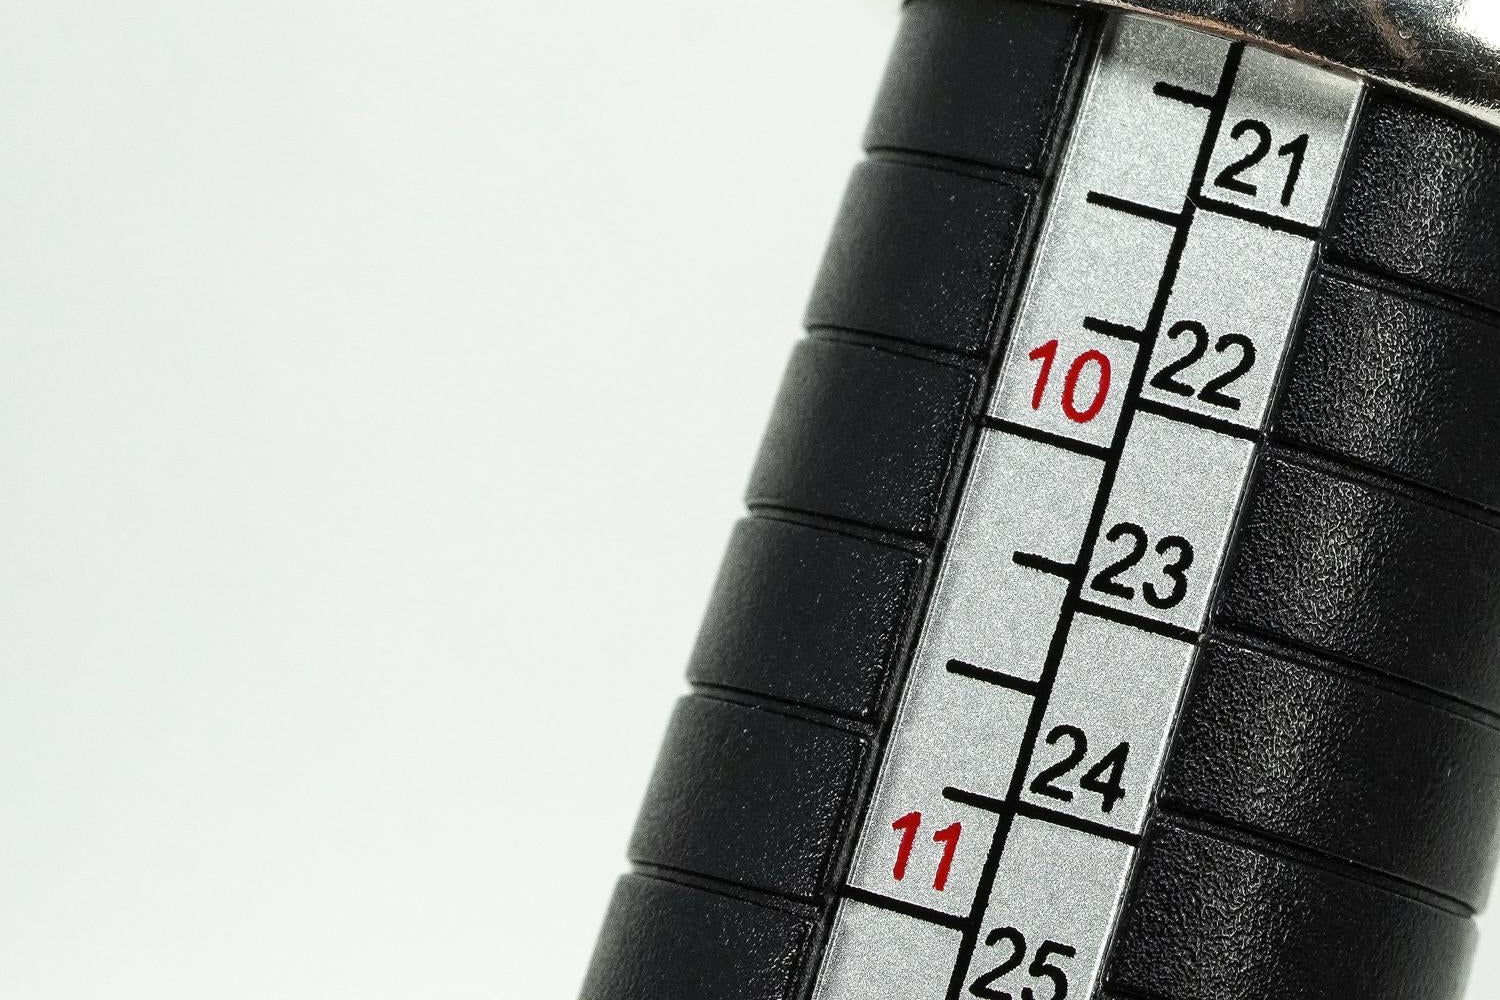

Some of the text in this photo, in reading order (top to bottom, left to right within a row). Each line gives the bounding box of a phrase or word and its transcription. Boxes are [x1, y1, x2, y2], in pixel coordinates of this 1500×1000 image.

[1213, 118, 1310, 207] 21
[1028, 339, 1112, 424] 10
[1150, 319, 1258, 411] 22
[1090, 521, 1195, 610] 23
[1029, 724, 1131, 813] 24
[891, 810, 962, 892] 11
[968, 926, 1077, 1000] 25
